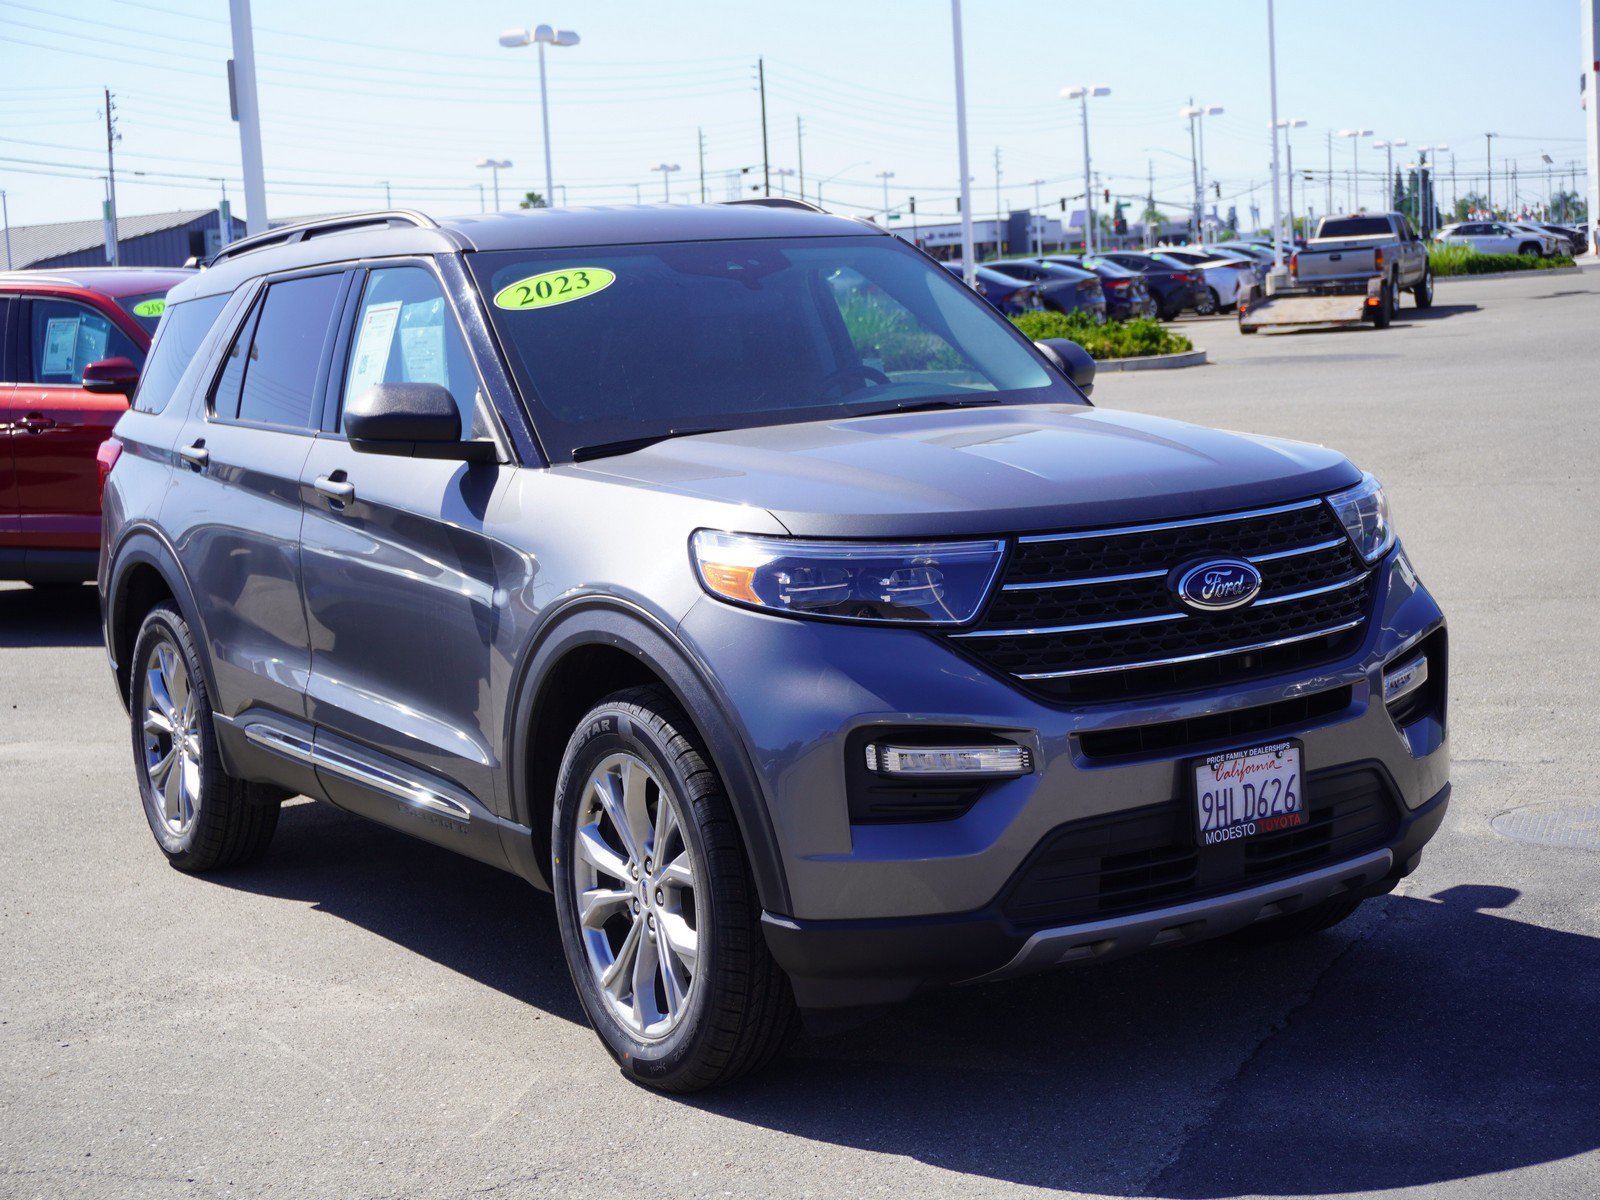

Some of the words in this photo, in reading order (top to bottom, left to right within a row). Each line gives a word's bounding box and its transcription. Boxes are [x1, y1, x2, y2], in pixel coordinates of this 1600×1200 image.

[516, 271, 590, 306] 2023
[1202, 570, 1246, 600] Ford
[1206, 754, 1225, 765] PRICE
[1225, 750, 1248, 761] FAMILY
[1249, 742, 1291, 756] DEALERSHIPS
[1215, 758, 1282, 783] California
[1202, 774, 1296, 831] 9HLD626
[1205, 822, 1256, 845] MODESTO
[1259, 814, 1301, 833] TOYOTA
